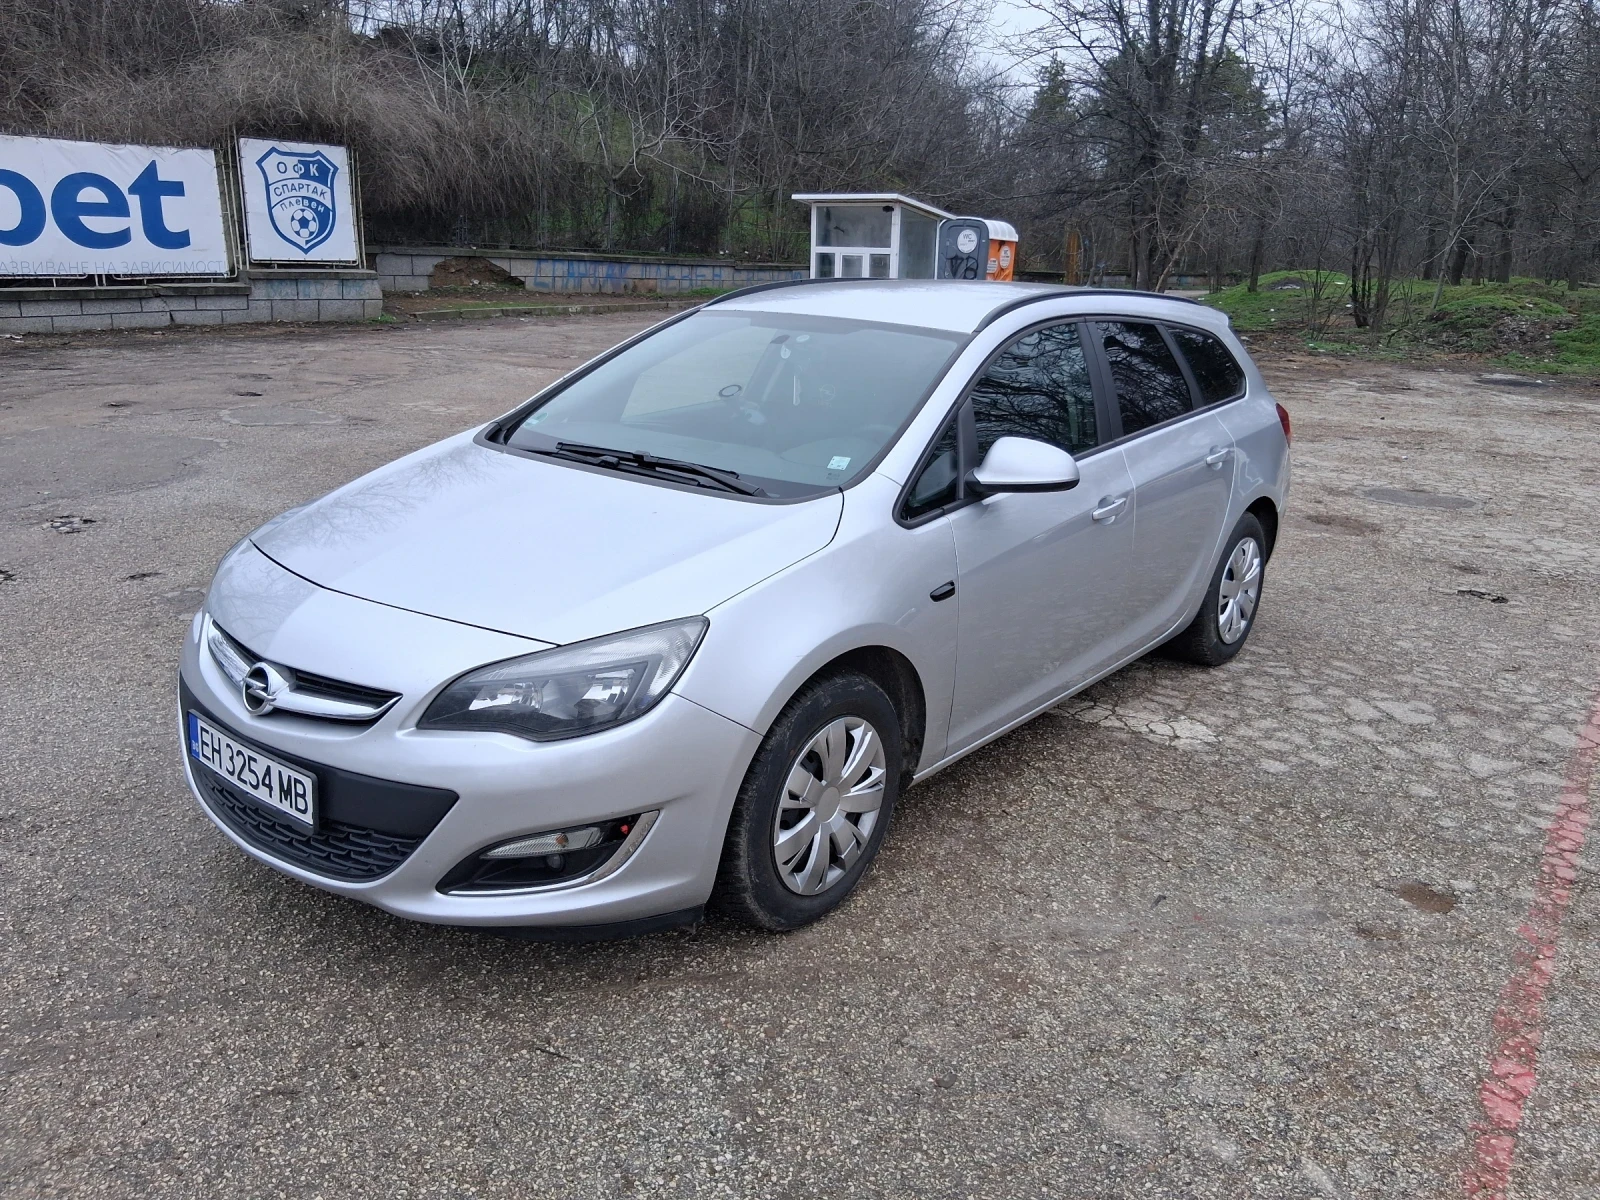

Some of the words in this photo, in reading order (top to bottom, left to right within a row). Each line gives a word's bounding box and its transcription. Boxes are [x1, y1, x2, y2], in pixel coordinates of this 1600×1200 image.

[276, 161, 319, 176] ОФК
[274, 183, 327, 200] СПАРТАК
[94, 261, 117, 273] НА
[200, 725, 222, 770] EH
[225, 742, 273, 799] 3254
[278, 769, 309, 815] MB
